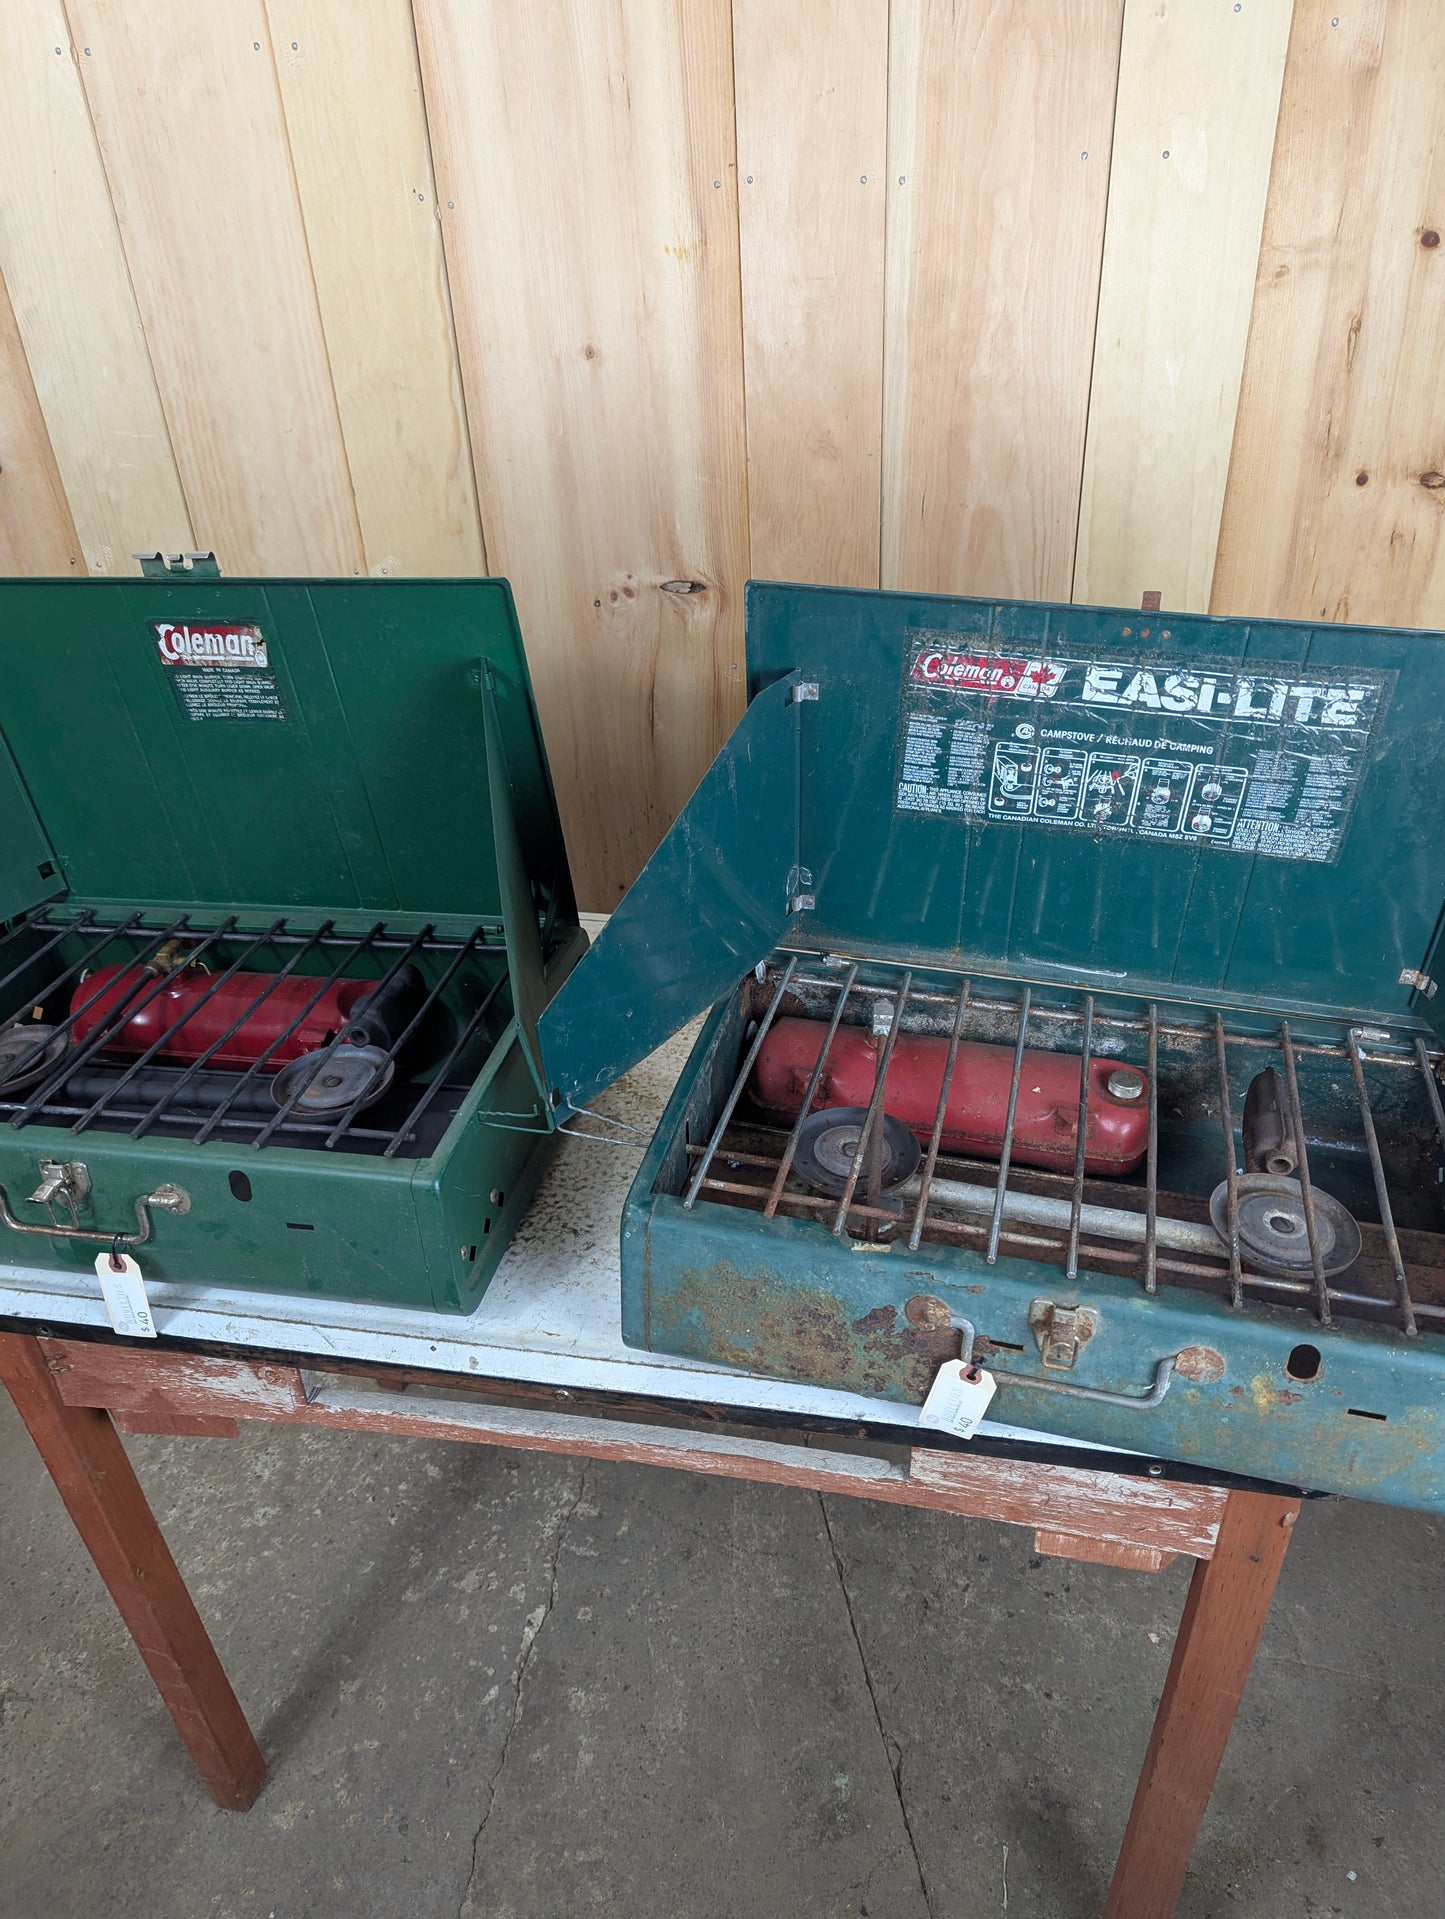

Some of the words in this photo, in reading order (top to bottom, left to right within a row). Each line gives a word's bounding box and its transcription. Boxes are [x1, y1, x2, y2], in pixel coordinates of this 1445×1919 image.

[158, 623, 255, 660] Coleman
[1081, 665, 1365, 726] EASI-LITE
[1040, 728, 1096, 743] CAMPSTOVE
[1153, 740, 1168, 750] DE
[1169, 742, 1214, 756] CAMPING
[1002, 814, 1039, 823] CANADIAN
[1039, 818, 1074, 827] COLEMAN
[1138, 829, 1168, 839] CANADA
